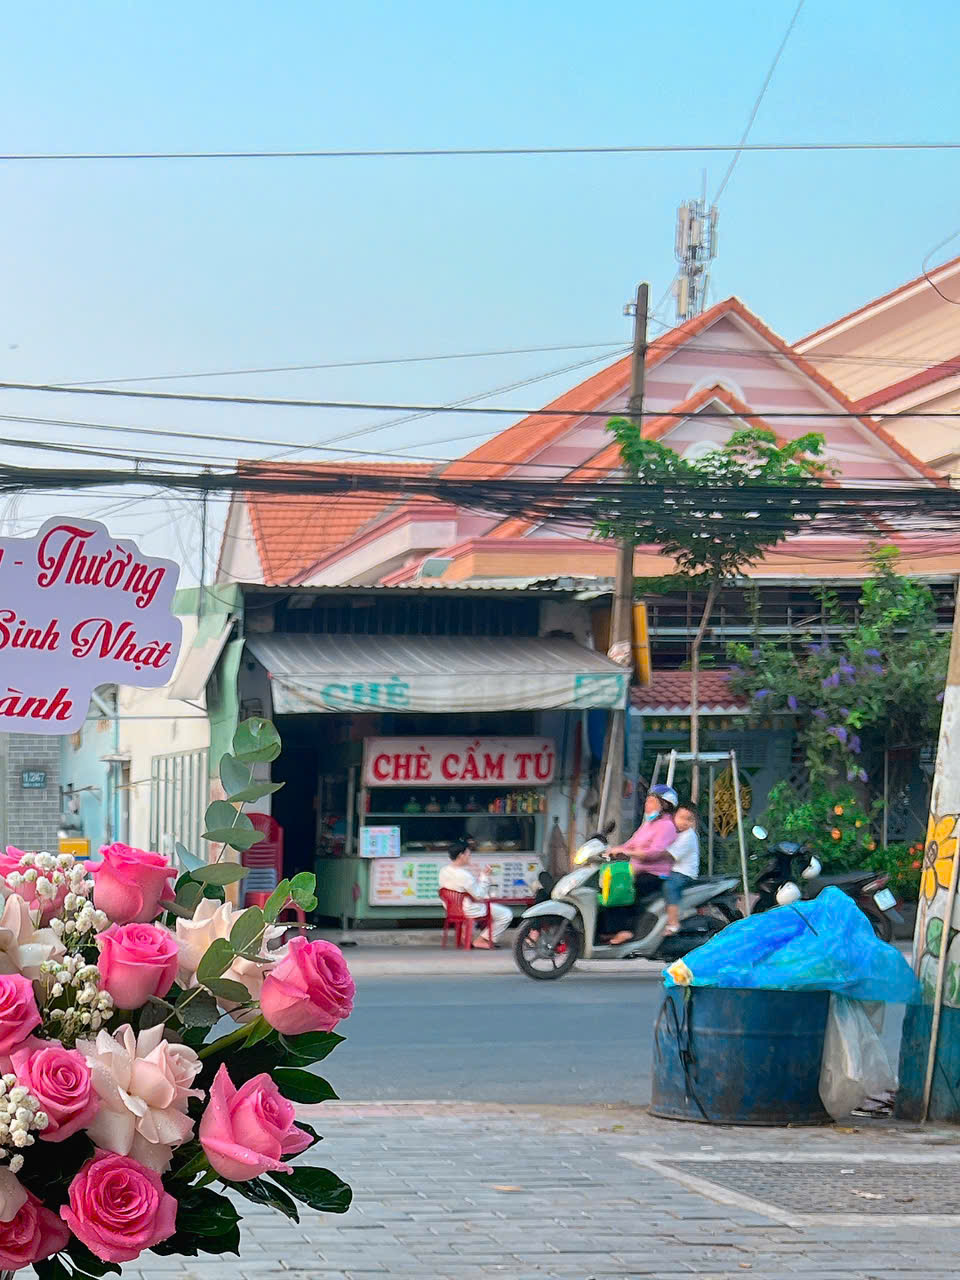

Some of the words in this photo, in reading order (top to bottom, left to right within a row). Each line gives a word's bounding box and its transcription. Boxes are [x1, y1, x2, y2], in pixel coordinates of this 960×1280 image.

[37, 524, 166, 609] Thường
[71, 617, 173, 671] Nhật
[373, 745, 432, 781] CHÈ
[513, 744, 555, 780] TÚ
